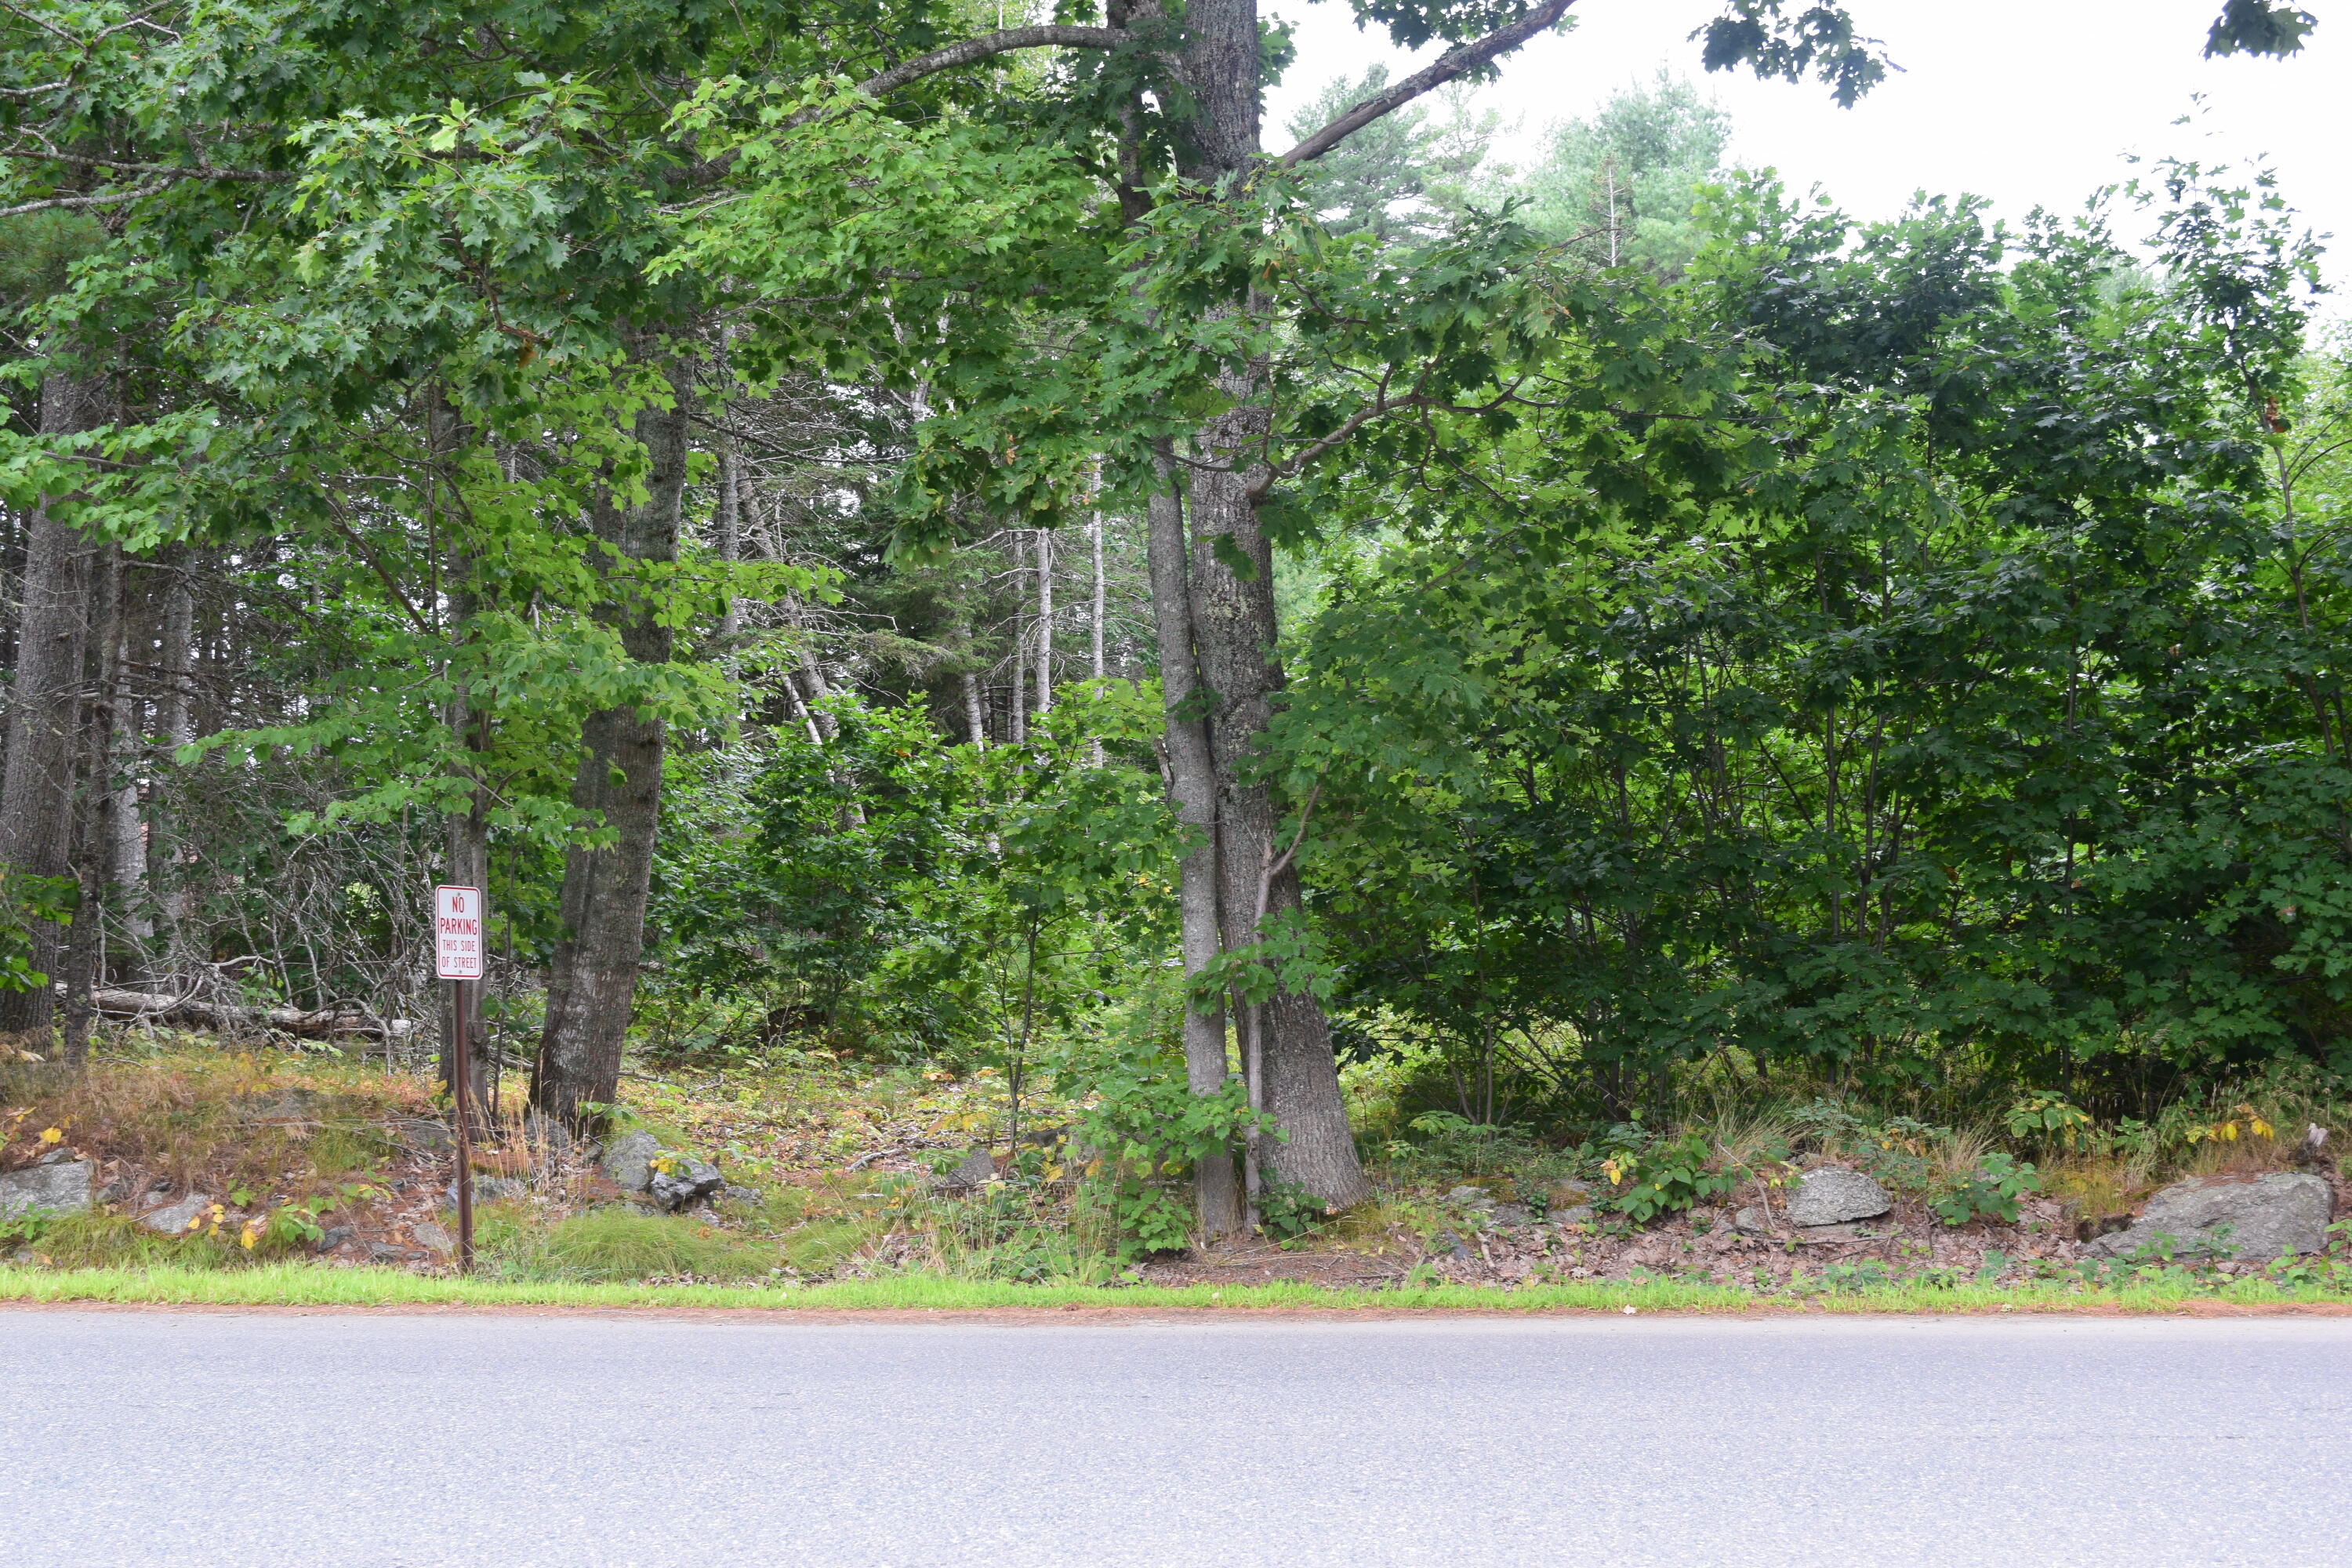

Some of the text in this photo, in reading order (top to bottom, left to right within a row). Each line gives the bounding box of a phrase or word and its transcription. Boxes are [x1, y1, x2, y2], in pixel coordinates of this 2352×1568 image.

[452, 897, 464, 913] NO
[441, 917, 477, 935] PARKING
[443, 939, 476, 952] THIS SIDE
[441, 956, 477, 968] OF STREET
